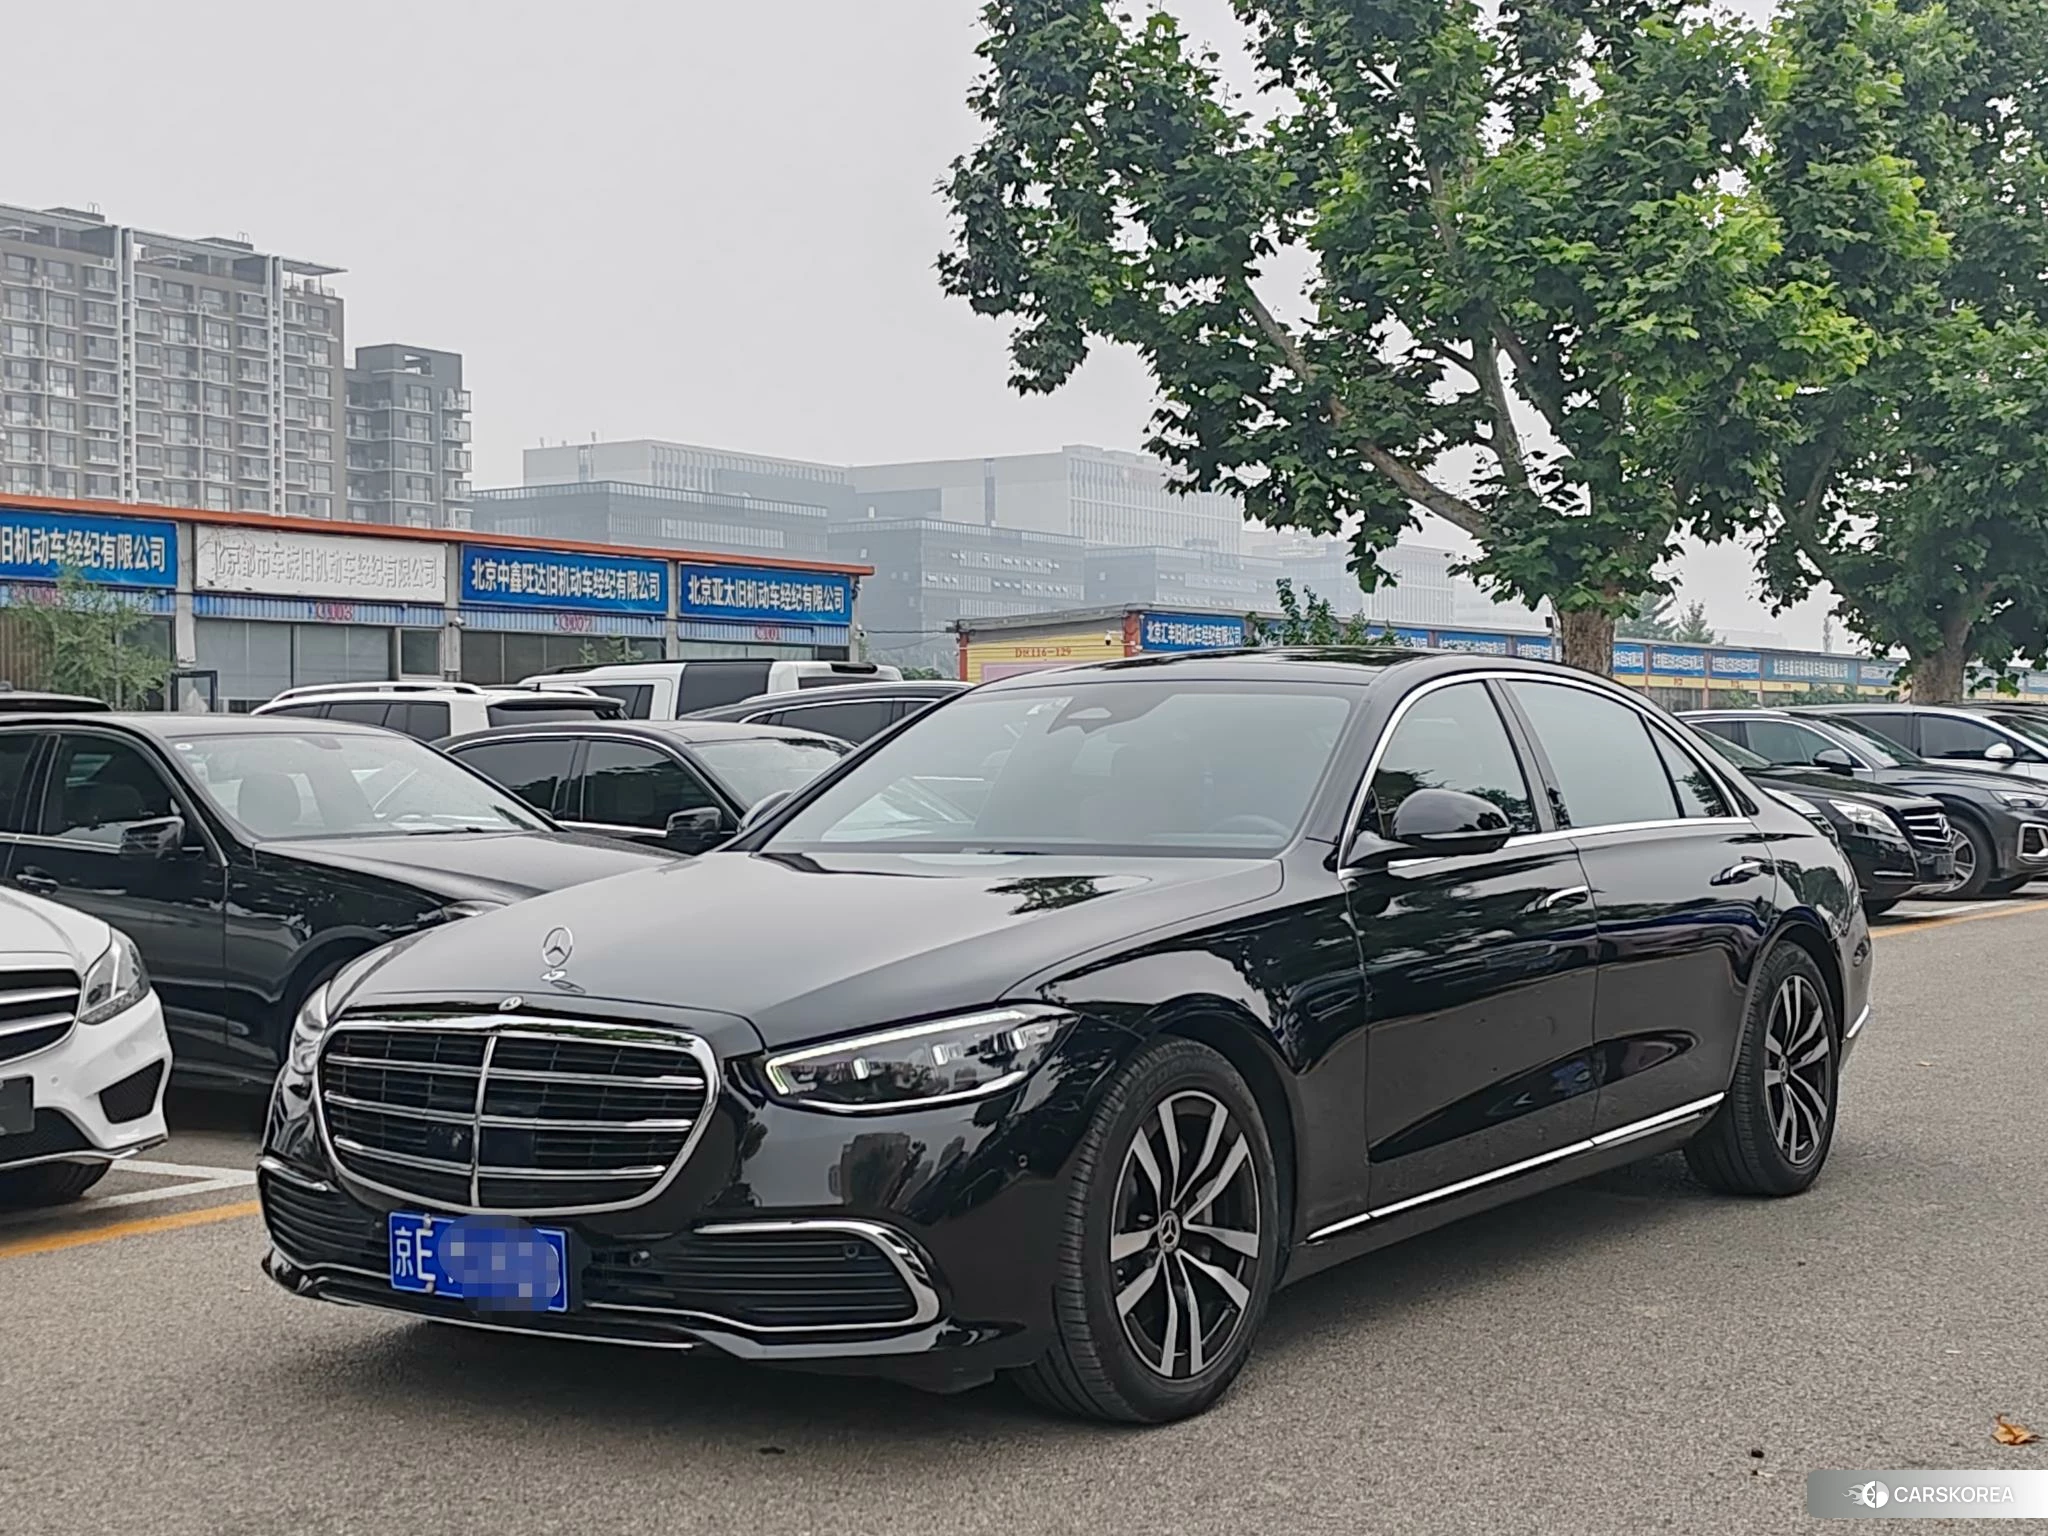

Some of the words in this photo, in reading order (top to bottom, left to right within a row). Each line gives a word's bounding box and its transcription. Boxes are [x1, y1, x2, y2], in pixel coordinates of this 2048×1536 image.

[687, 574, 845, 614] 北京亚太旧机动车经纪有限公司
